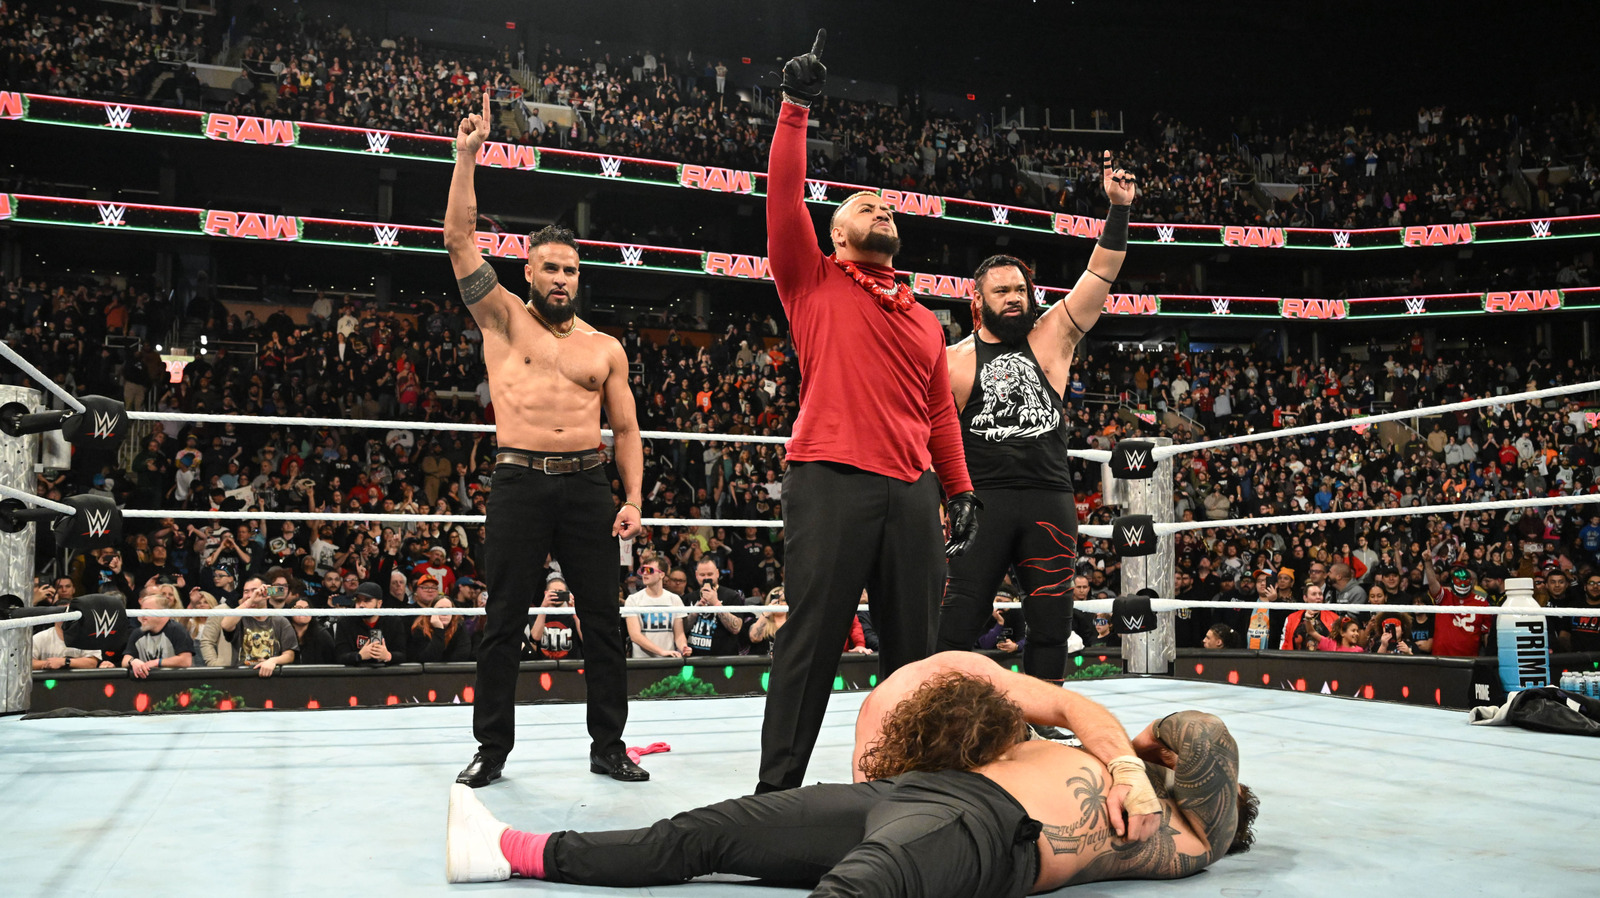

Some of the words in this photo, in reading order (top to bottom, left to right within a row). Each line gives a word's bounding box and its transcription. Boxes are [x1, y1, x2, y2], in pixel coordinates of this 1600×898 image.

[207, 113, 295, 146] RAW
[680, 164, 752, 194] RAW
[205, 210, 299, 241] RAW
[1223, 226, 1285, 248] RAW
[1403, 223, 1473, 247] RAW
[473, 231, 530, 259] RA
[1281, 299, 1346, 320] RAW
[1484, 289, 1562, 313] RAW
[1515, 621, 1548, 688] PRIME
